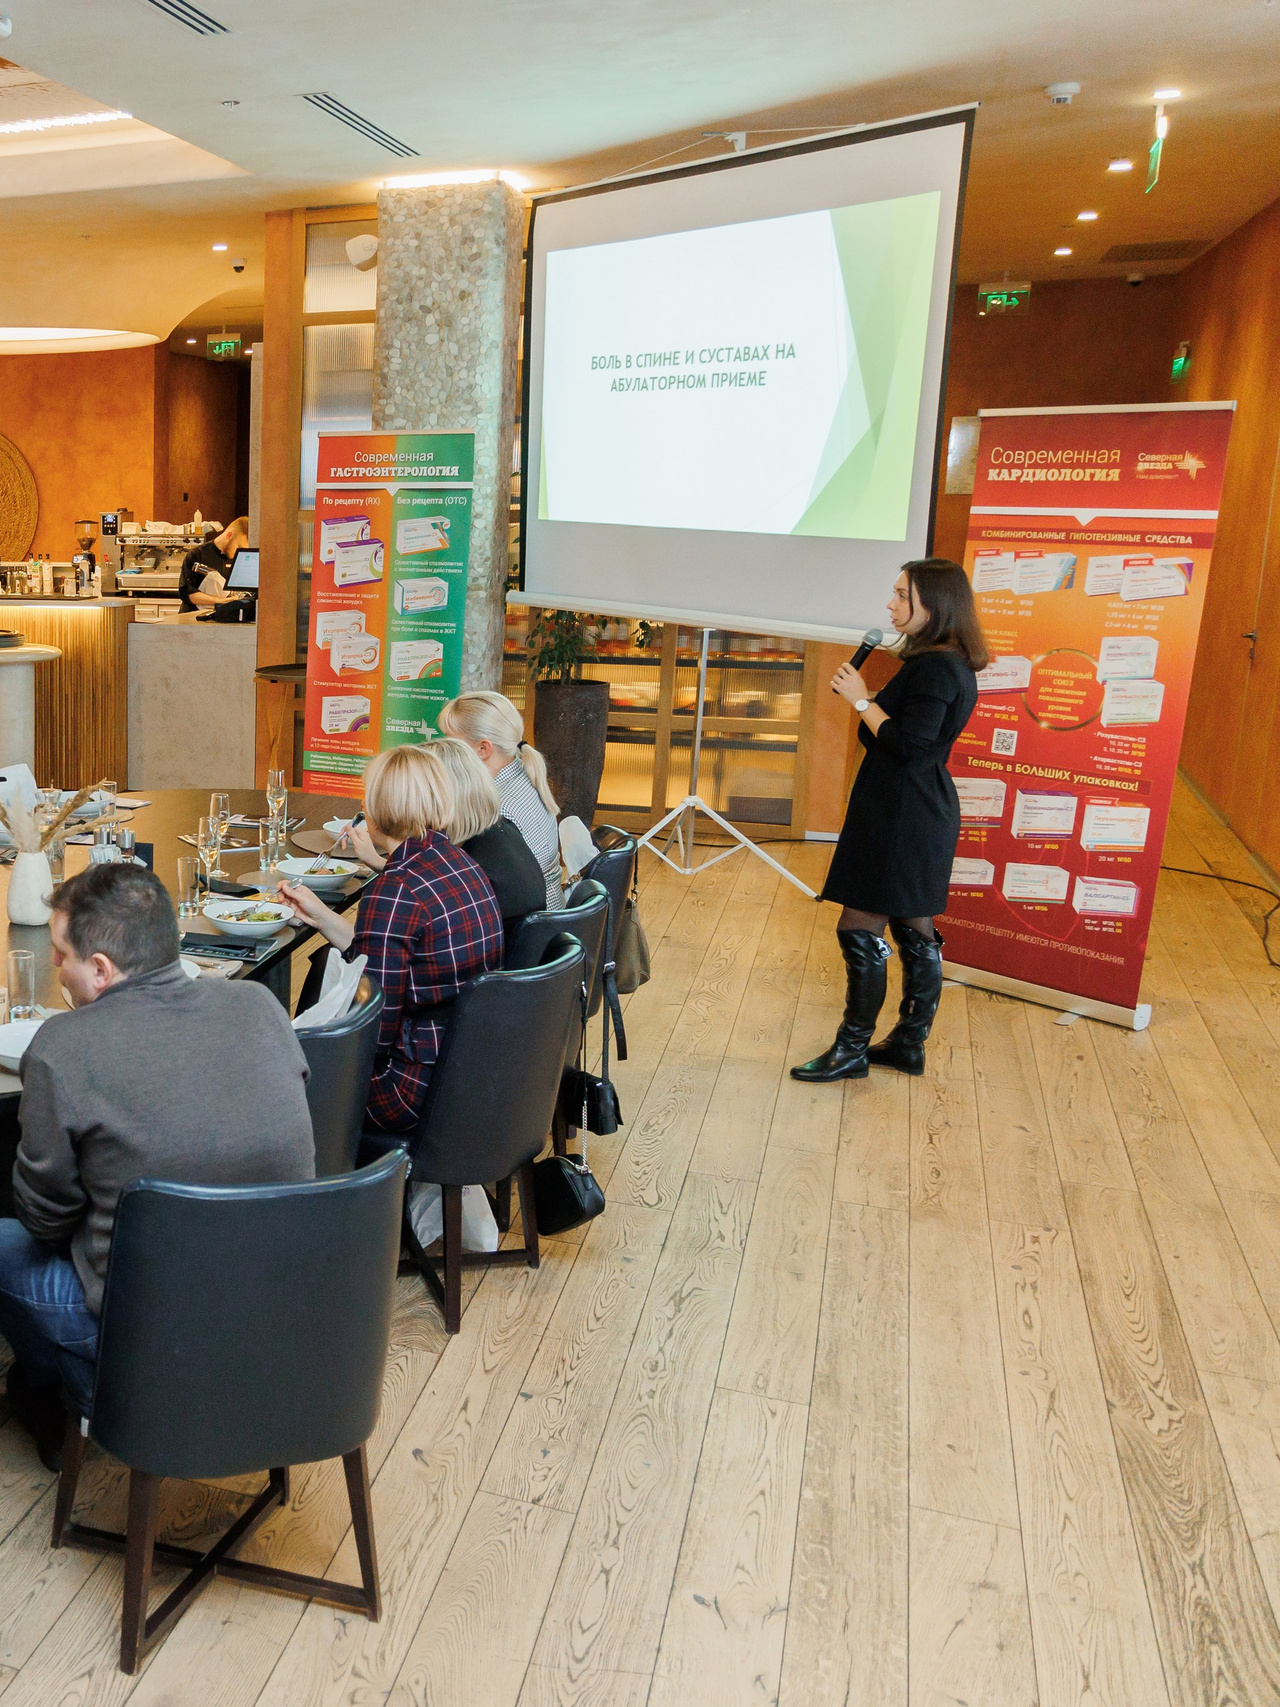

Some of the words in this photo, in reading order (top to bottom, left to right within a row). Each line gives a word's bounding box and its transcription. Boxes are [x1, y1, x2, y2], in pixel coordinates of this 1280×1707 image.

[591, 355, 622, 370] БОЛЬ
[625, 354, 632, 369] В
[636, 351, 681, 369] СПИНЕ
[685, 350, 695, 365] И
[699, 345, 771, 364] СУСТАВАХ
[775, 343, 796, 360] НА
[610, 374, 706, 392] АБУЛАТОРНОМ
[711, 371, 767, 388] ПРИЕМЕ
[354, 452, 434, 464] Современная
[990, 447, 1121, 467] Современная
[1138, 452, 1183, 462] Северная
[330, 466, 459, 477] ГАСТРОЭНТЕРОЛОГИЯ
[987, 469, 1121, 483] КАРДИОЛОГИЯ
[366, 497, 381, 505] (RX)
[982, 530, 1066, 540] КОМБИНИРОВАННЫЕ
[1069, 532, 1141, 542] ГИПОТЕНЗИВНЫЕ
[1145, 535, 1193, 544] СРЕДСТВА
[1038, 669, 1093, 680] ОПТИМАЛЬНЫЙ
[314, 680, 342, 688] Стимулятор
[1053, 679, 1074, 687] СОЮЗ
[1054, 688, 1087, 697] снижения
[1038, 695, 1084, 705] повышенного
[386, 717, 421, 727] Северная
[1038, 712, 1080, 721] холестерина
[386, 725, 414, 734] ЗВЕЗДА
[968, 757, 1004, 771] Теперь
[1006, 764, 1012, 772] в
[1015, 764, 1071, 781] БОЛЬШИХ
[1073, 774, 1139, 791] упаковках!
[975, 923, 985, 932] ПО
[1016, 933, 1049, 947] ИМЕЮТСЯ
